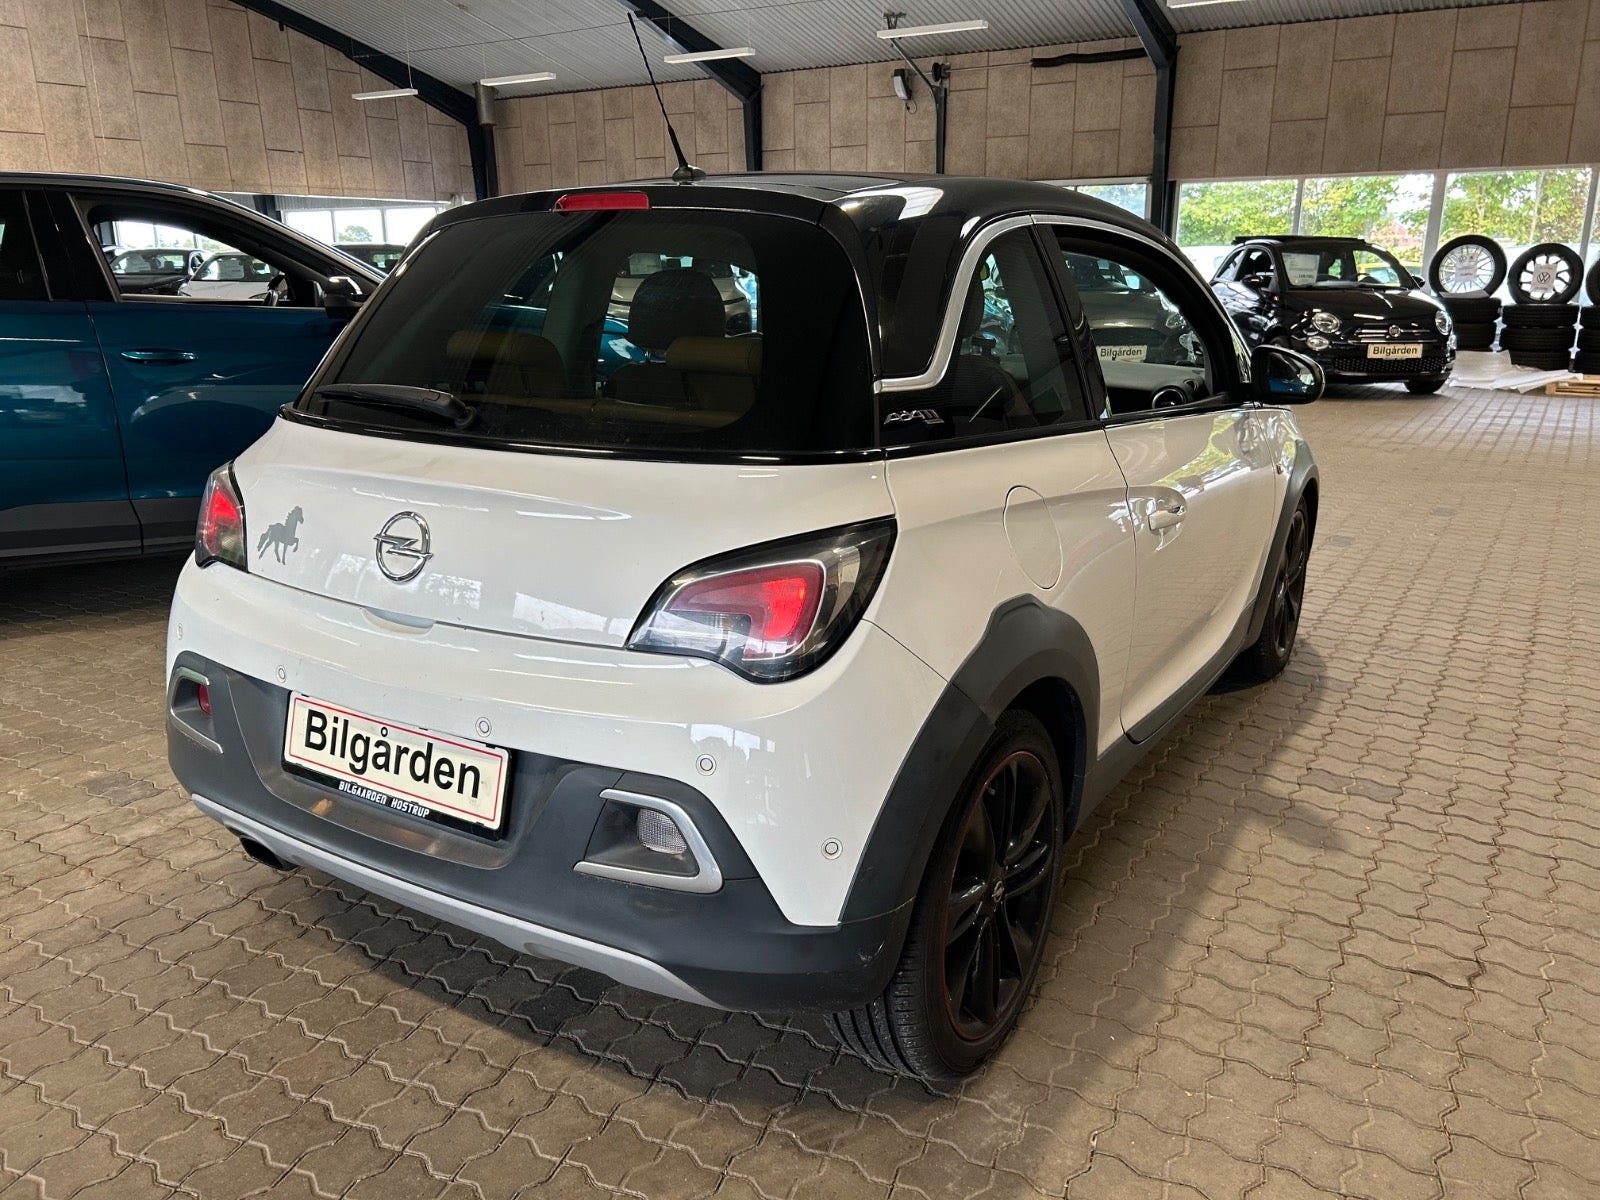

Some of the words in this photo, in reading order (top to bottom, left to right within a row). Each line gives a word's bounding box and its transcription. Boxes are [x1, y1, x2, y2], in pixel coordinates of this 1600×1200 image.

[1373, 346, 1417, 356] Bilgården
[304, 708, 481, 799] Bilgården
[338, 781, 388, 805] BILGAARDEN
[391, 796, 430, 818] HOSTRUP
